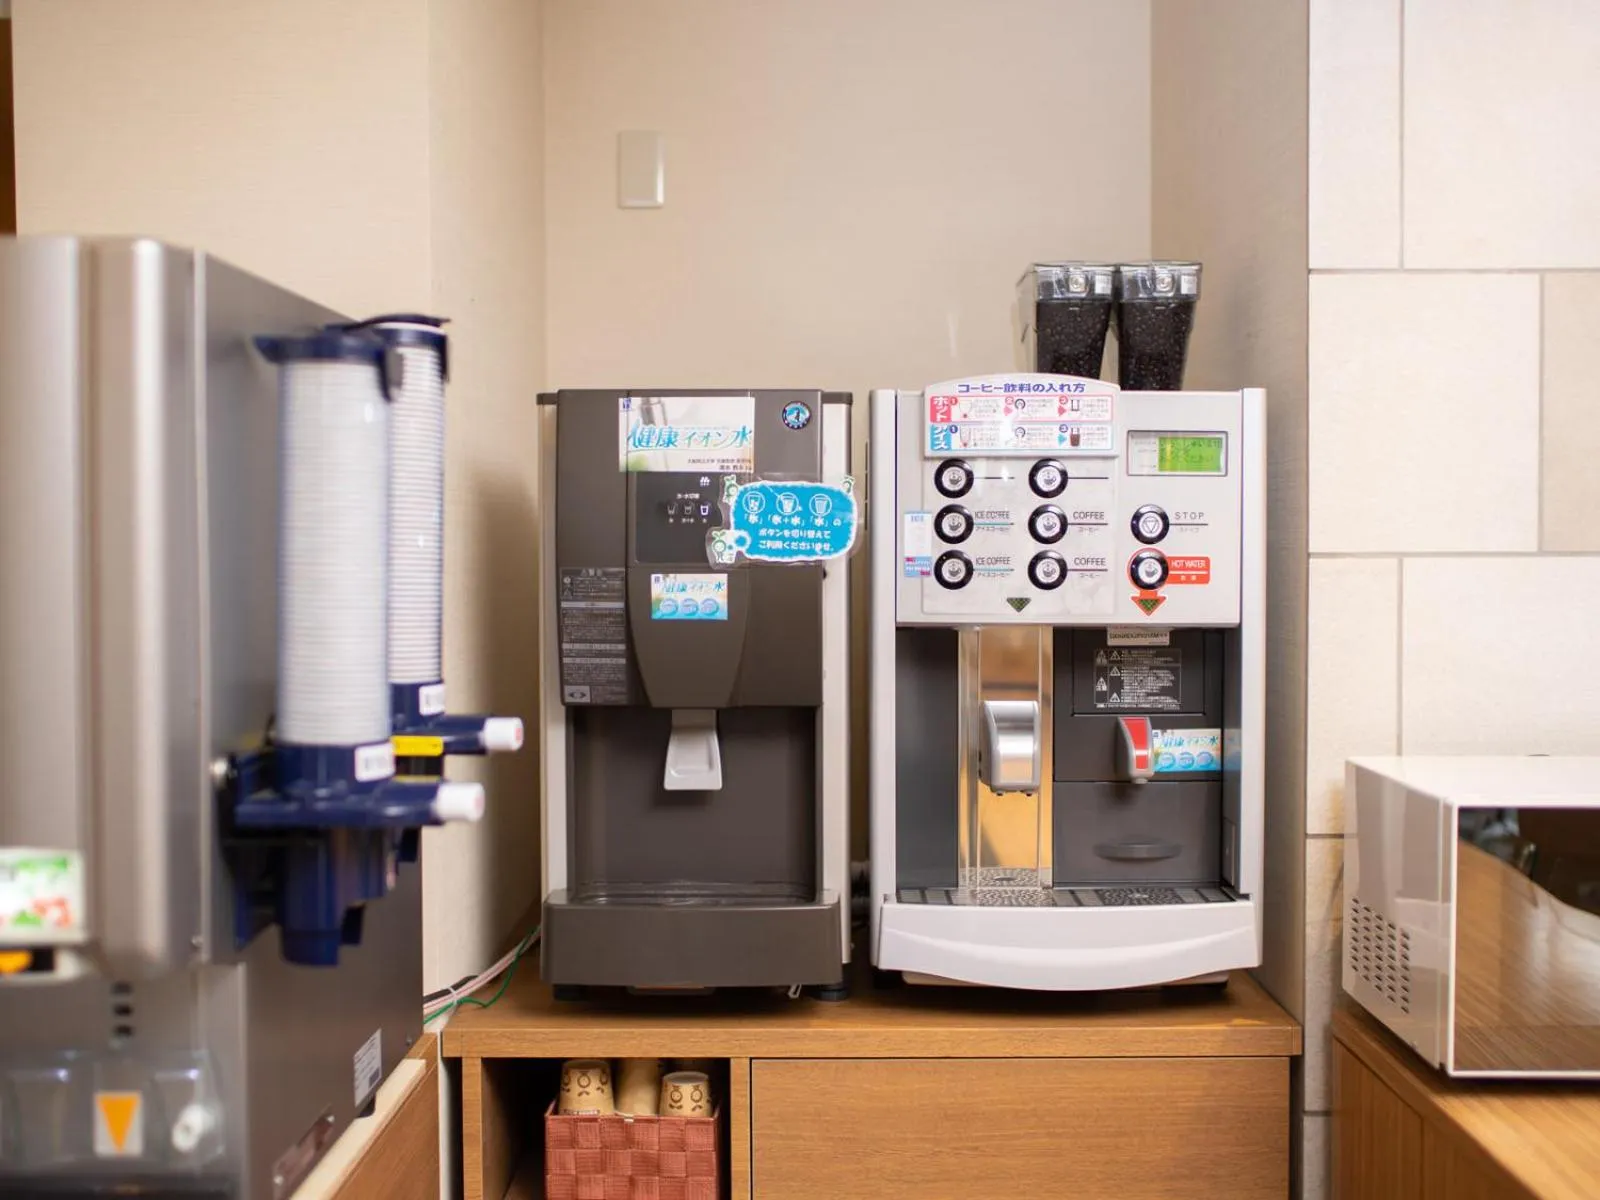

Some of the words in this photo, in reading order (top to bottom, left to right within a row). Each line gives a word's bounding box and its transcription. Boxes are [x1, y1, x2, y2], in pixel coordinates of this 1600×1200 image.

[957, 383, 1086, 394] コーヒー飲料の入れ方
[627, 420, 753, 449] 健康イオン水
[1072, 511, 1105, 521] COFFEE
[1174, 511, 1205, 520] STOP
[1073, 557, 1106, 566] COFFEE
[1171, 559, 1185, 568] HOT
[1185, 559, 1206, 568] WATER
